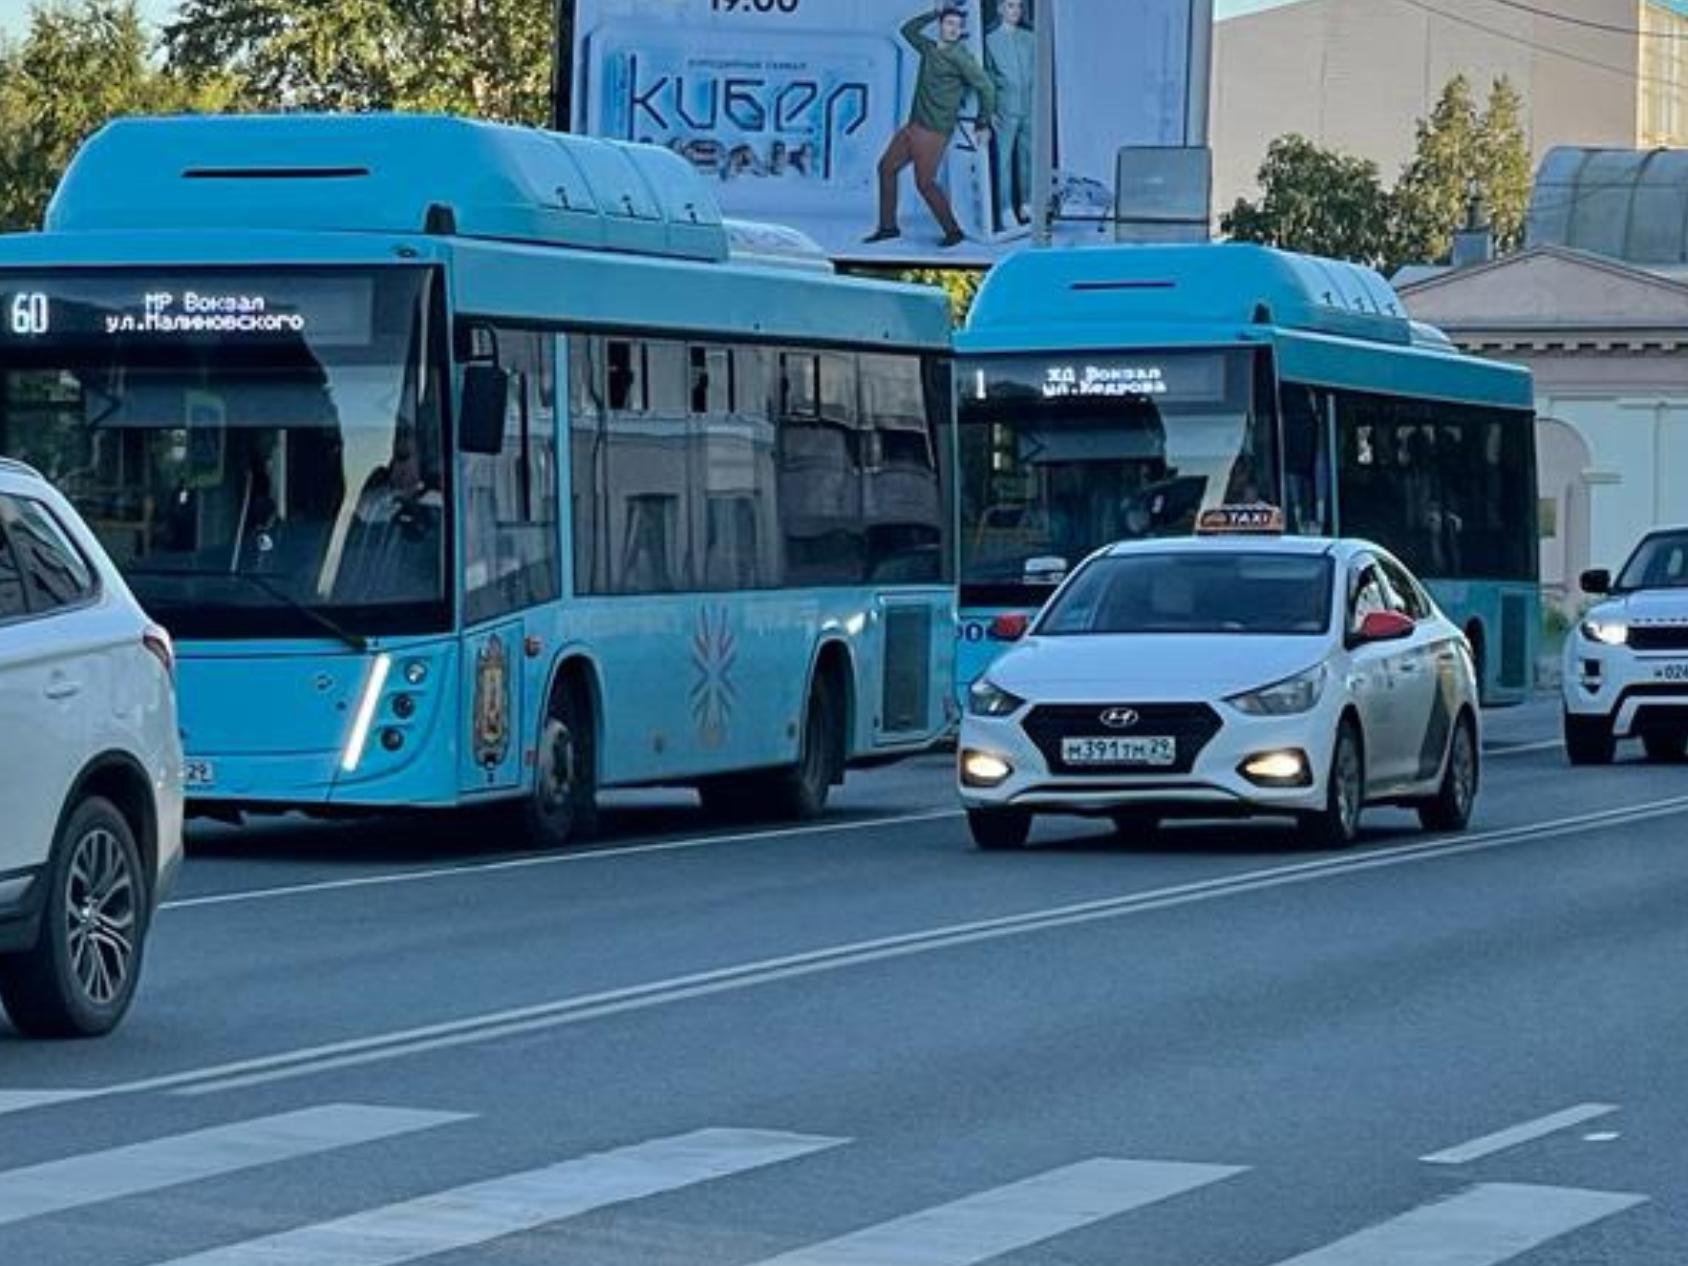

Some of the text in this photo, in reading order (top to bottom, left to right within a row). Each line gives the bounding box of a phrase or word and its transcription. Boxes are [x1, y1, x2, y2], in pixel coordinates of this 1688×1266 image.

[11, 293, 48, 333] 60
[184, 293, 264, 312] Вокзал
[976, 369, 986, 399] 1
[1230, 512, 1270, 523] TAXI
